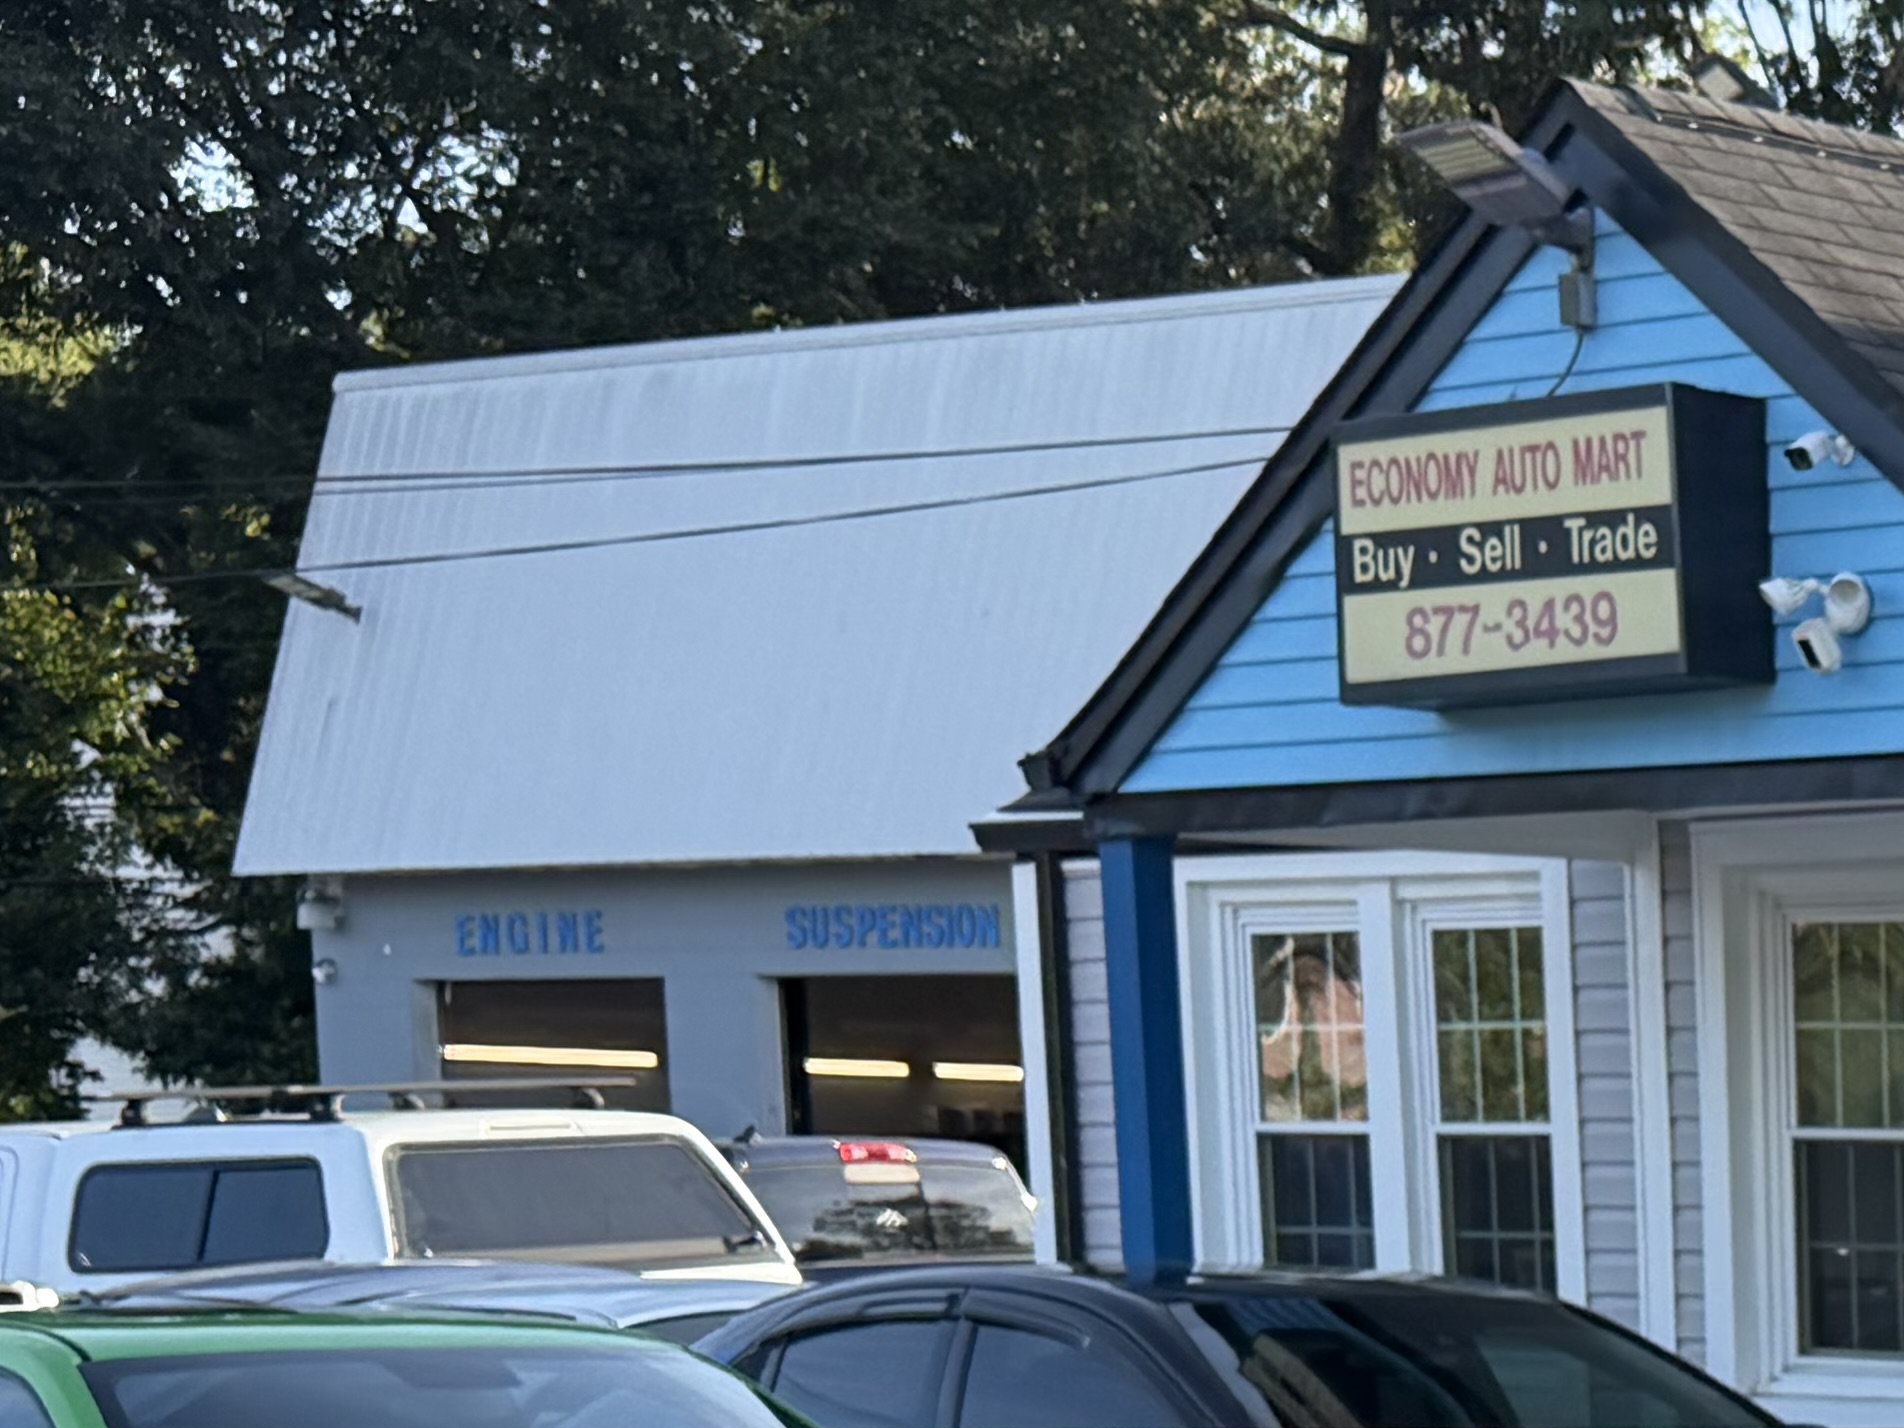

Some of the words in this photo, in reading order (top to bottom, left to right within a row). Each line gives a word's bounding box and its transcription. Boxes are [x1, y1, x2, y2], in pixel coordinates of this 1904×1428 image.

[1350, 449, 1480, 508] ECONOMY
[1492, 442, 1561, 497] AUTO
[1572, 430, 1648, 487] MART
[1352, 537, 1415, 589] Buy
[1459, 523, 1522, 574] Sell
[1563, 512, 1658, 566] Trade
[1404, 590, 1619, 661] 877-3439
[455, 909, 606, 957] ENGINE
[784, 903, 1000, 951] SUSPENSION
